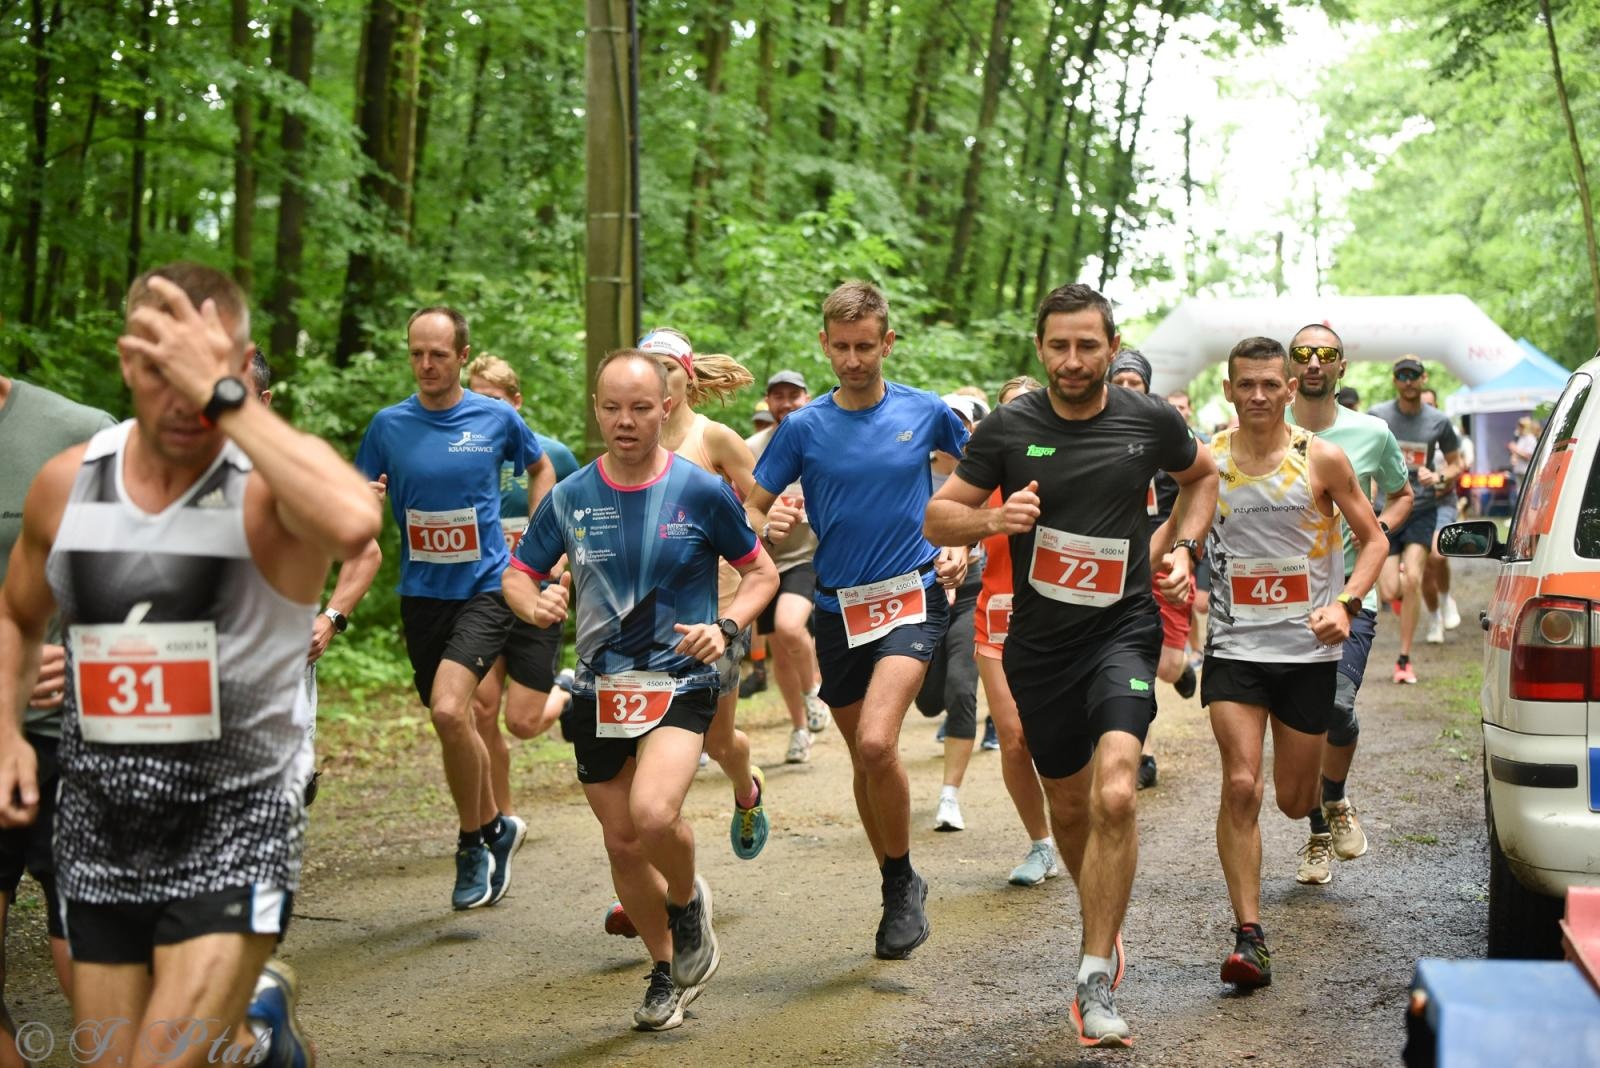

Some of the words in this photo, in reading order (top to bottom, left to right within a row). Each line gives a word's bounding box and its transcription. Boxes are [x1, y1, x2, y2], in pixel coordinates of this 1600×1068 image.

[419, 528, 466, 551] 100
[895, 582, 912, 591] 4500
[1058, 556, 1100, 590] 72
[1250, 578, 1288, 603] 46
[868, 598, 904, 628] 59
[107, 664, 172, 715] 31
[612, 693, 648, 721] 32
